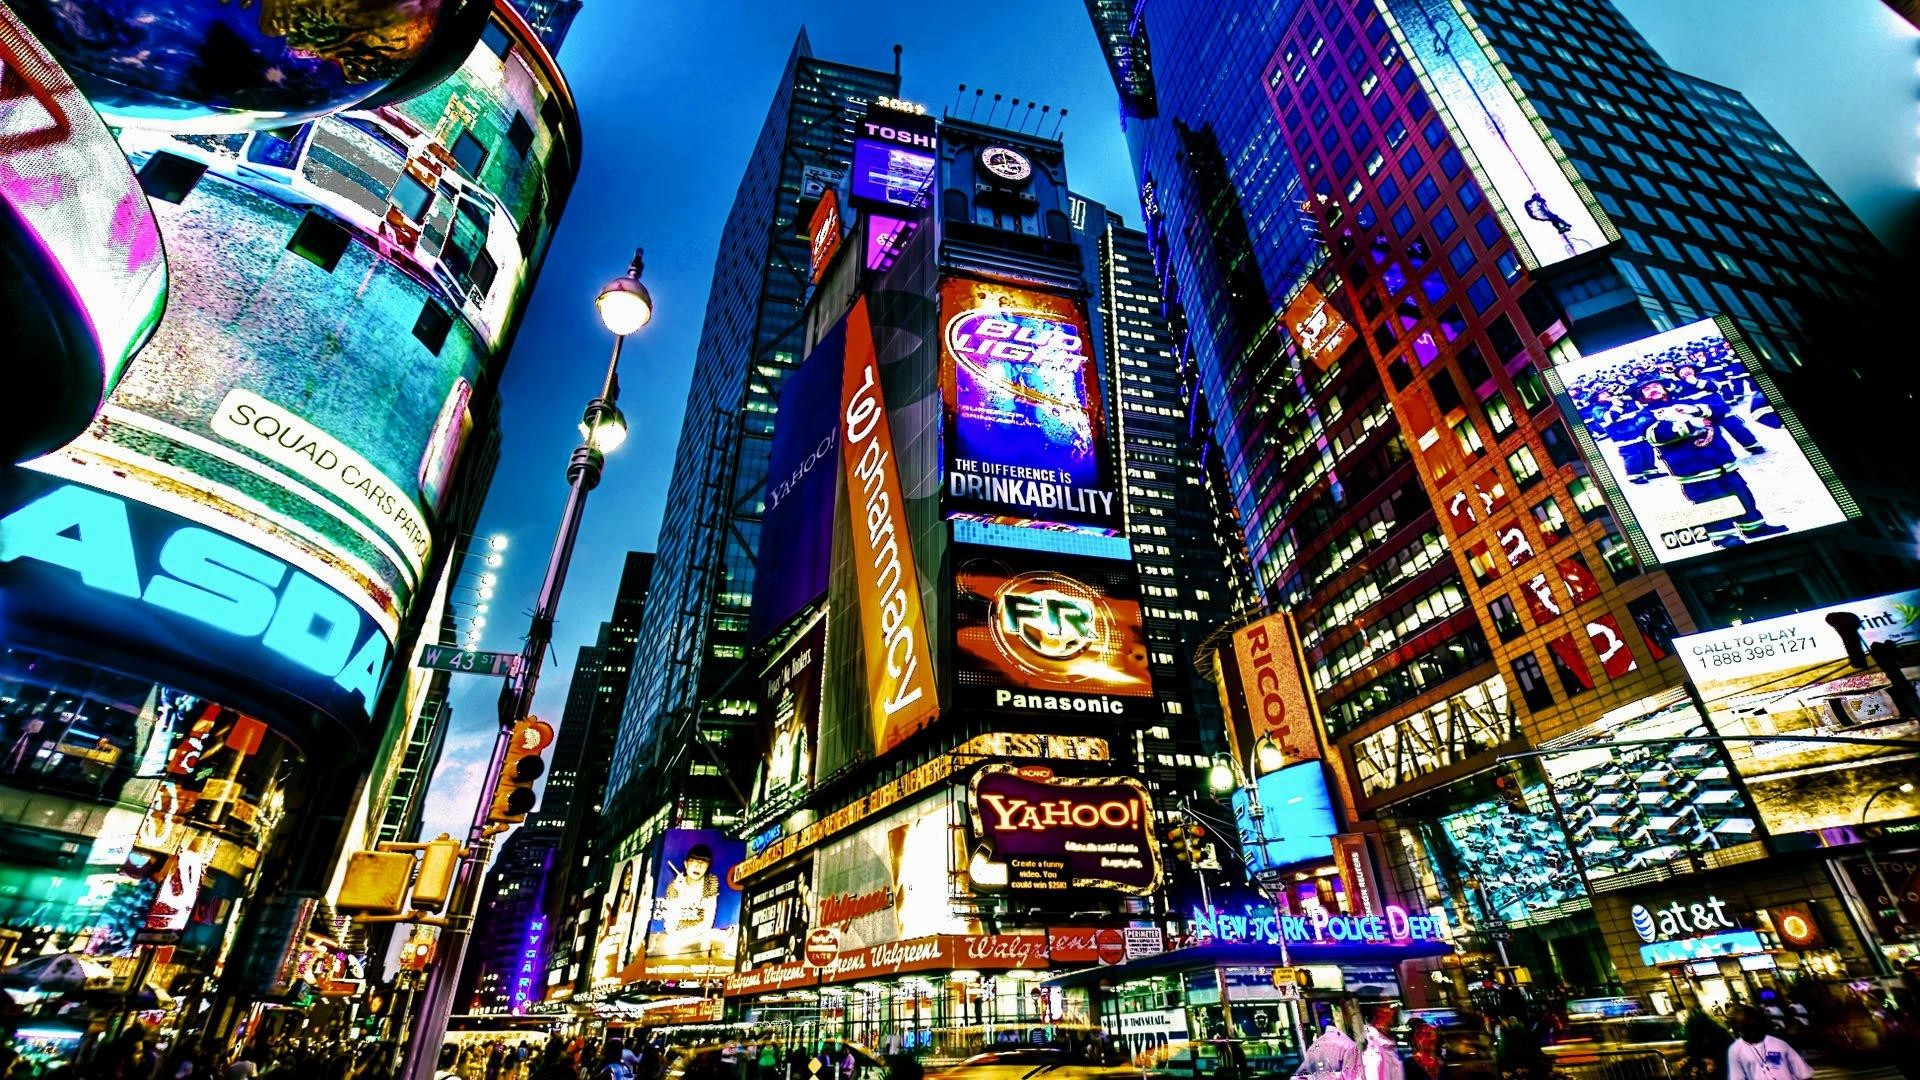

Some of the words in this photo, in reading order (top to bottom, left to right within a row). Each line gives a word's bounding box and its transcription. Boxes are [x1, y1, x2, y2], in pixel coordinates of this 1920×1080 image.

[228, 404, 338, 471] SQUAD
[341, 465, 396, 515] CARS
[769, 426, 837, 511] YAHOO!
[955, 458, 978, 473] THE
[982, 462, 1057, 483] DIFFERENCE
[951, 471, 1113, 516] DRINKABILITY
[854, 436, 923, 715] pharmacy
[1692, 641, 1732, 657] CALL
[1734, 636, 1754, 648] TO
[1759, 627, 1797, 643] PLAY
[1713, 651, 1742, 667] 888
[1747, 644, 1775, 661] 398
[1780, 636, 1817, 655] 1271
[426, 648, 442, 666] W
[449, 651, 475, 680] 43
[481, 655, 497, 664] ST
[996, 689, 1124, 714] Panasonic
[1247, 624, 1296, 757] RICOH
[1020, 769, 1051, 778] VACANCY
[981, 794, 1139, 830] YAHOO!
[1011, 859, 1036, 868] Create
[1043, 860, 1064, 869] funny
[1011, 881, 1032, 889] could
[1193, 904, 1247, 940] NEW
[1312, 905, 1385, 941] POLICE
[1386, 905, 1442, 940] DEPT
[1656, 896, 1735, 936] at&t
[871, 939, 944, 973] Walgreens
